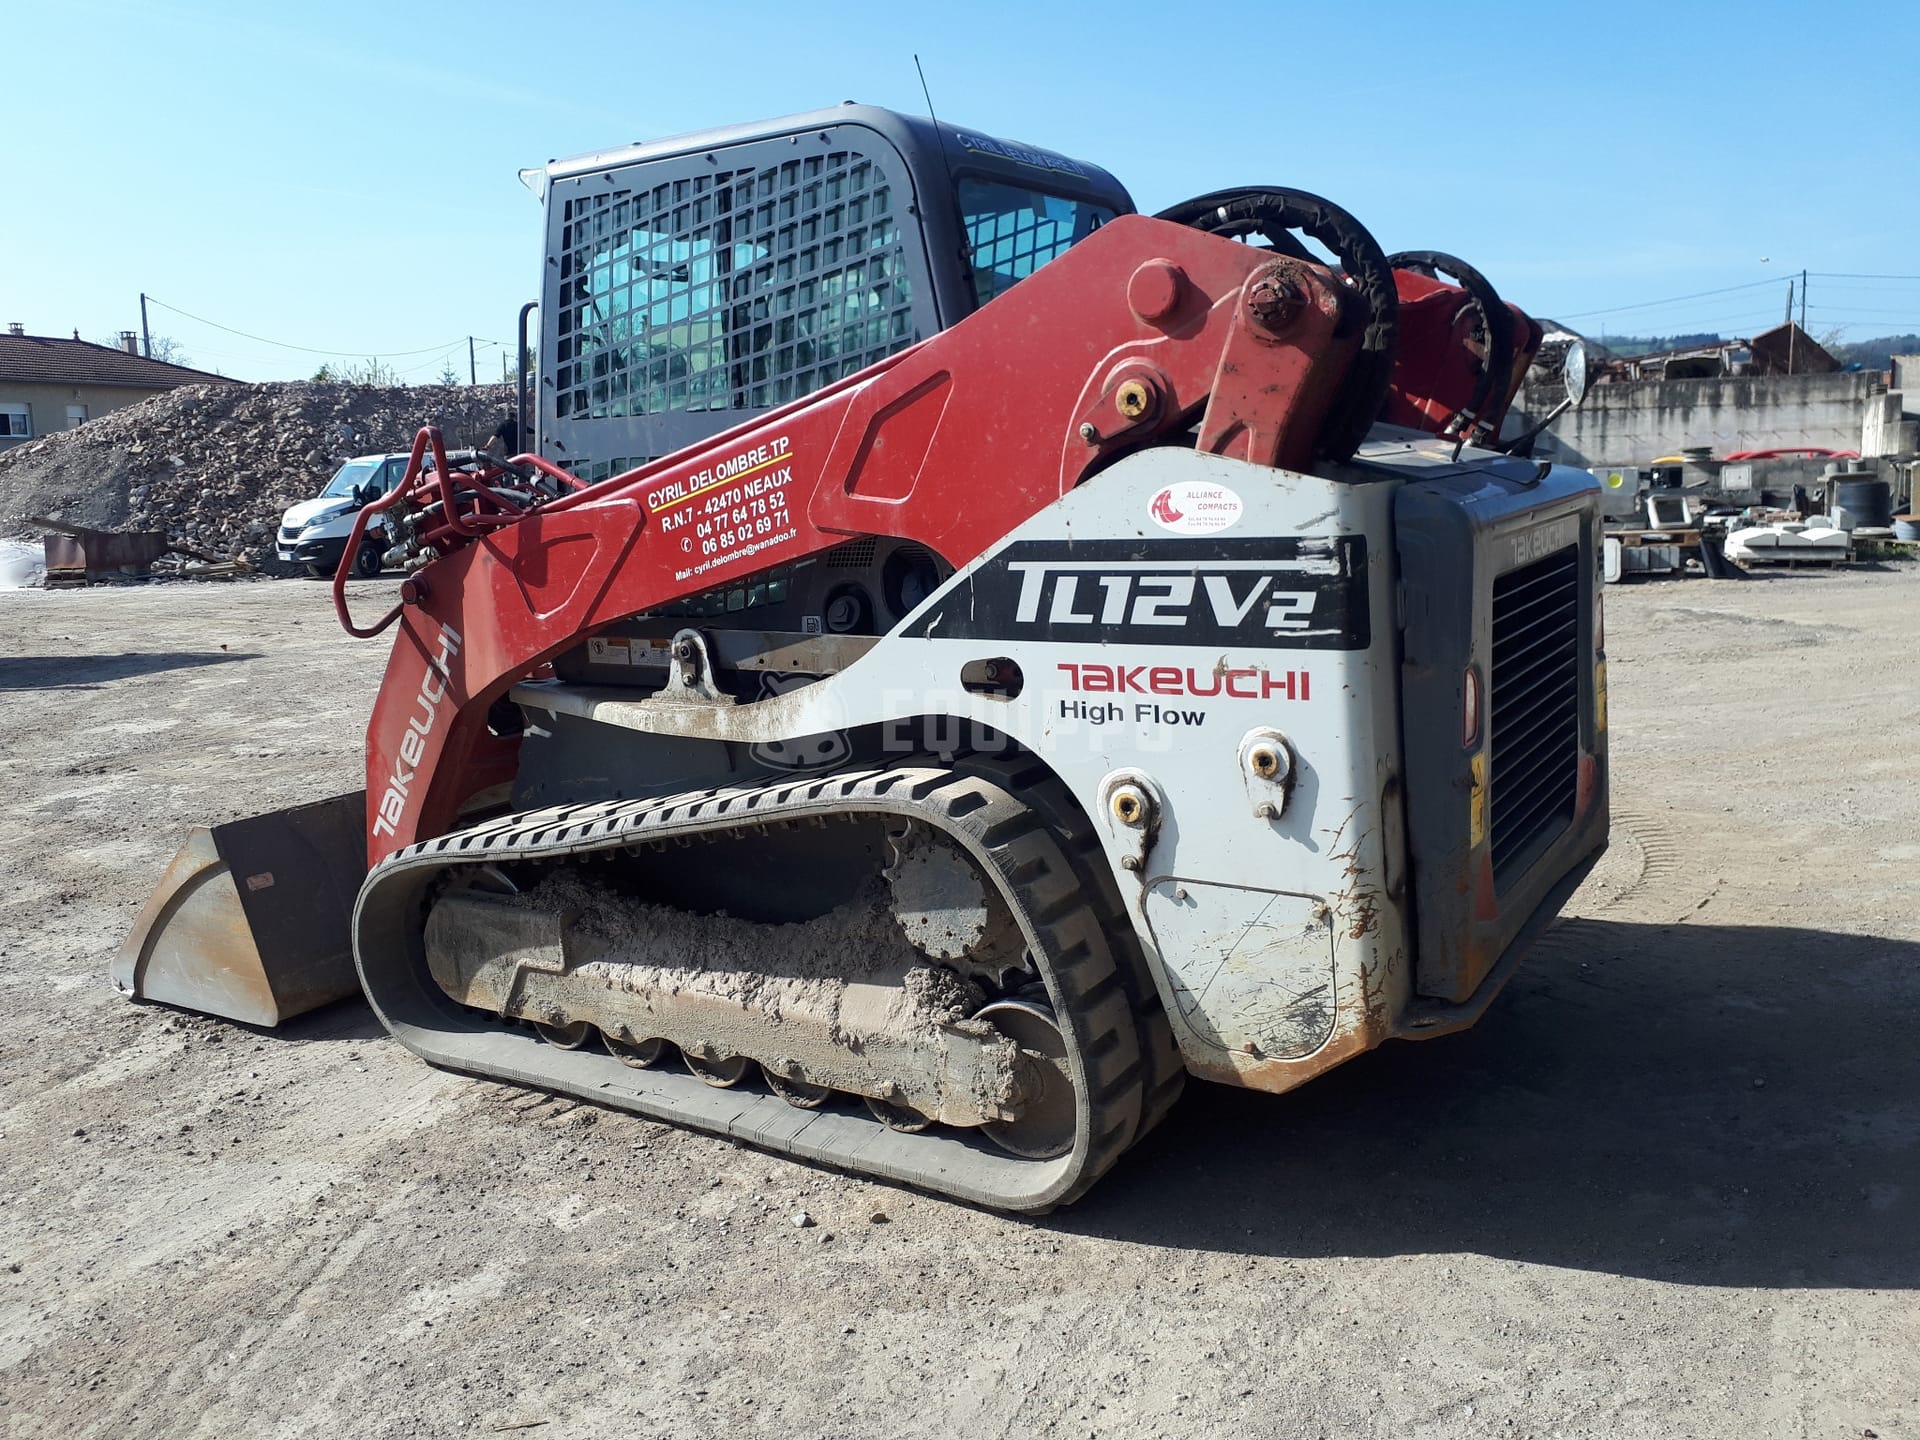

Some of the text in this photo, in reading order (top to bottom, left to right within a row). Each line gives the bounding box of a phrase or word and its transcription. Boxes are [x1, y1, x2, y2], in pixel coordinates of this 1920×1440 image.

[648, 436, 789, 508] CYRIL DELOMBRE.TP
[1186, 491, 1223, 499] ALLIANCE
[661, 507, 693, 533] R.N.7
[704, 488, 742, 515] 42470
[743, 466, 793, 500] NEAUX
[696, 491, 785, 538] 04 77 64 78 52
[1197, 503, 1238, 511] COMPACTS
[675, 527, 797, 582] Mail: cyril.delombre@wanadoo.fr
[702, 508, 789, 555] 06 85 02 69 71
[1057, 663, 1311, 701] TAKEUCHI
[372, 622, 463, 838] TAKEUCHI
[1059, 699, 1206, 727] High Flow
